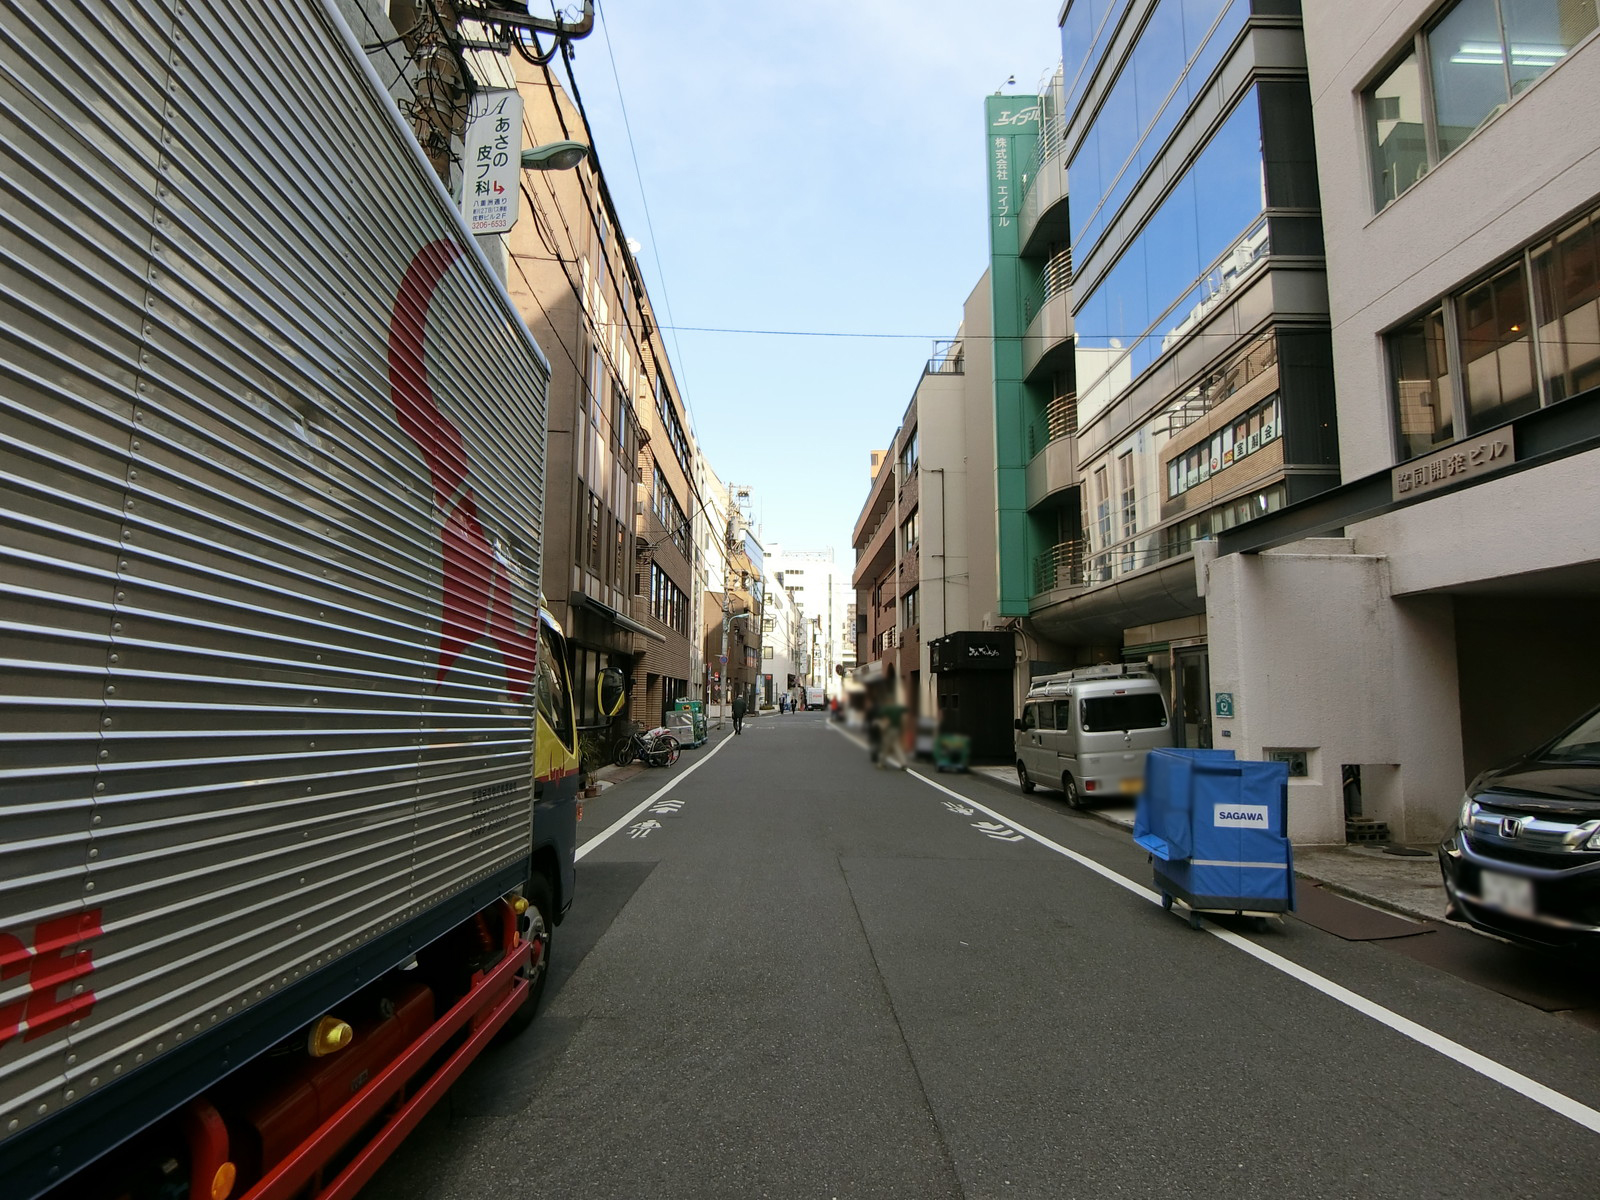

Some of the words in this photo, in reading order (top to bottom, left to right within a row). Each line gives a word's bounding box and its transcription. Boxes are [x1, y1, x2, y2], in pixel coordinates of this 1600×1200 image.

[493, 117, 510, 168] あさの
[995, 137, 1008, 181] 株式会社
[474, 145, 492, 197] 皮フ科
[473, 197, 507, 207] 八重洲通り
[997, 186, 1010, 227] エイブル
[471, 219, 507, 230] 3206-6533
[1219, 811, 1264, 822] SAGAWA
